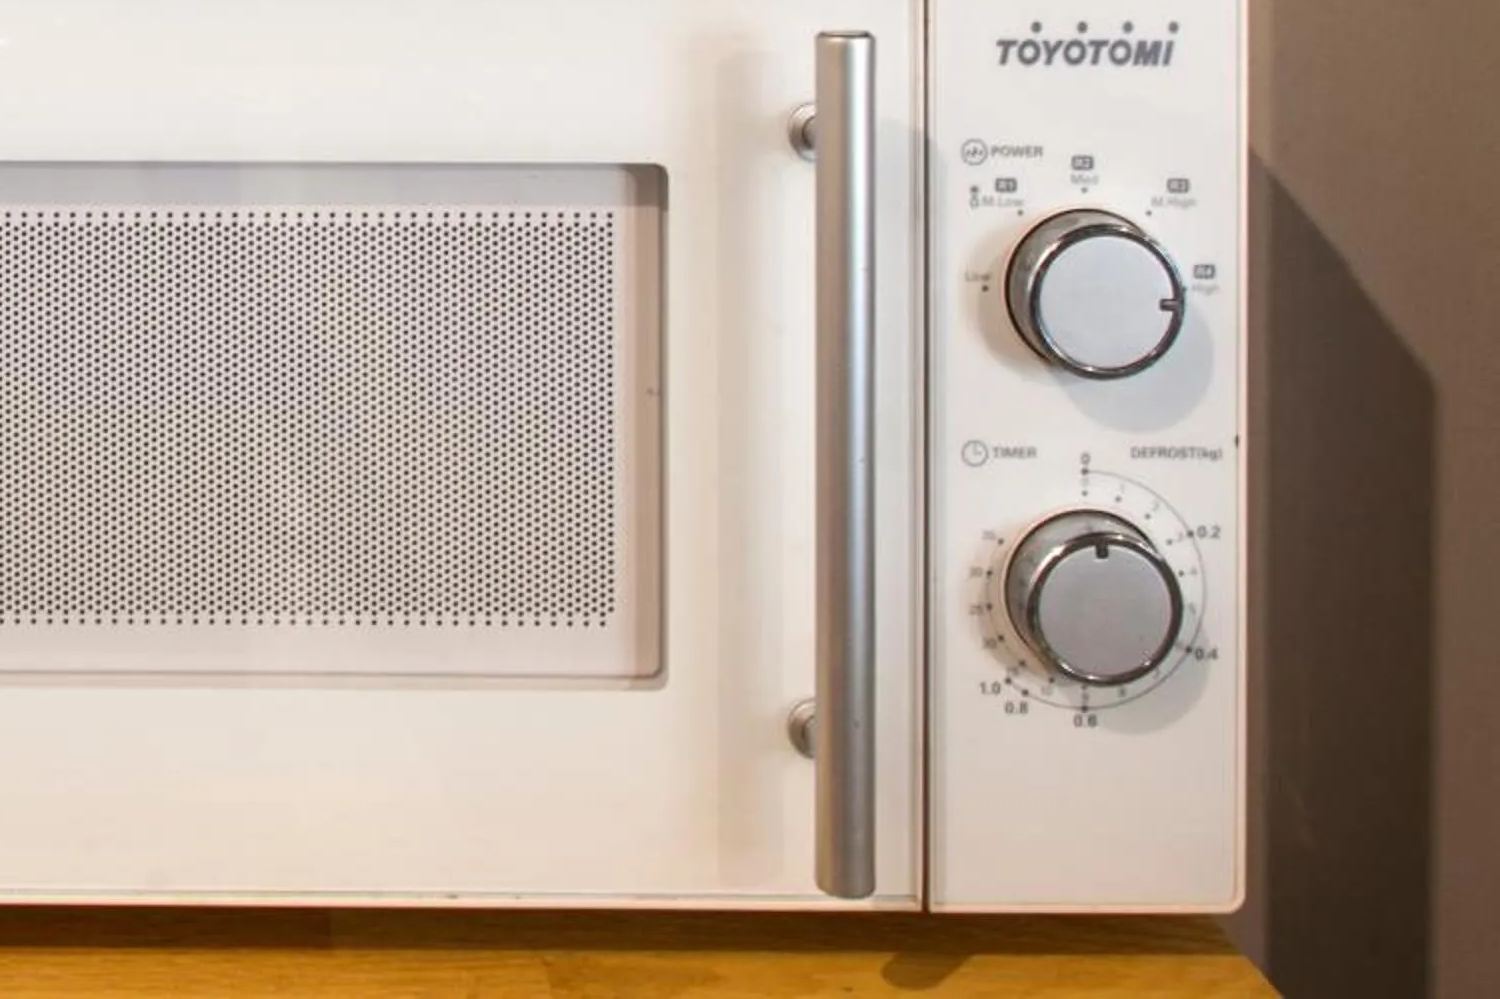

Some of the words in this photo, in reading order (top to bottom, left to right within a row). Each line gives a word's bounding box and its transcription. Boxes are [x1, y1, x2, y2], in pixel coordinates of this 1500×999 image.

[996, 39, 1176, 66] TOYOTOMI
[991, 145, 1043, 158] POWER
[992, 446, 1037, 459] TIMER
[1080, 452, 1091, 465] 0
[1197, 524, 1221, 539] 0.2
[1195, 647, 1219, 661] 0.4
[980, 682, 1001, 695] 1.0
